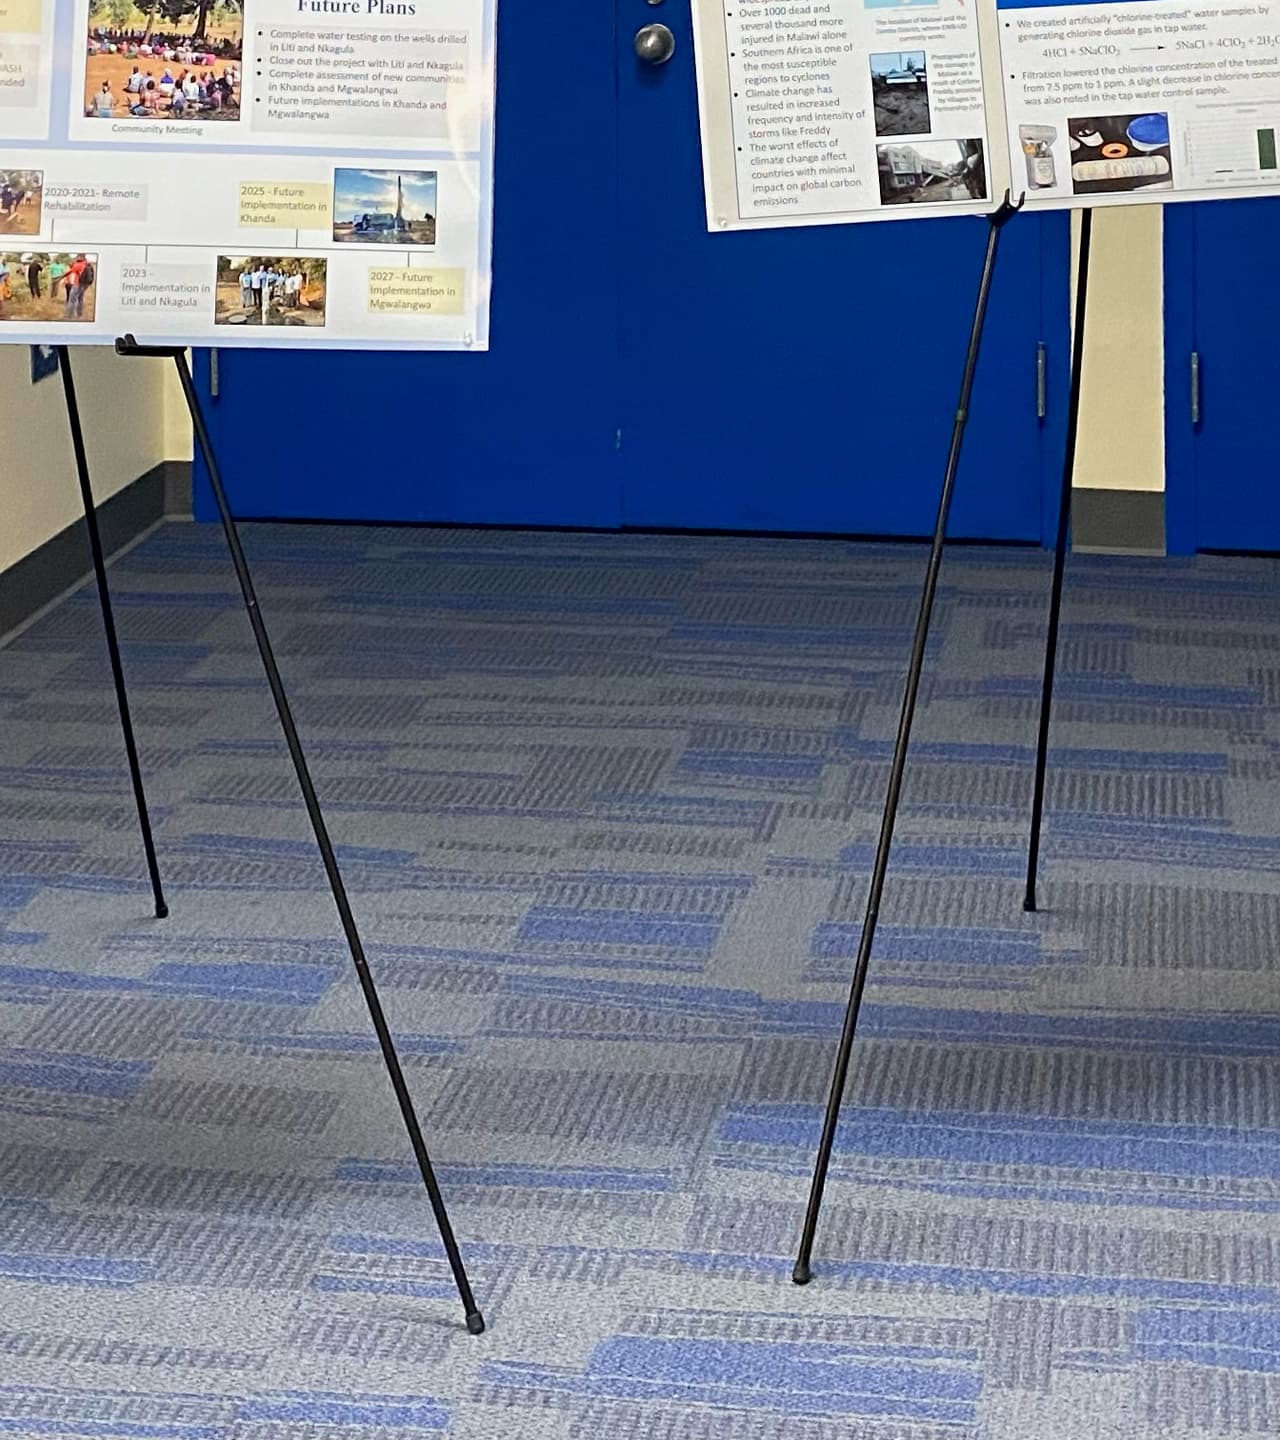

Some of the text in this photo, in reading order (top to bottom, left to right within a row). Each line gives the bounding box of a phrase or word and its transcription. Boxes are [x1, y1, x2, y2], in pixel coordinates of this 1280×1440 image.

[367, 0, 415, 15] Plans
[739, 4, 830, 17] Over 1000 dead and
[269, 30, 316, 41] Complete
[317, 31, 345, 40] water
[346, 32, 378, 43] testing
[394, 32, 409, 42] the
[411, 32, 435, 43] wells
[437, 32, 468, 44] drilled
[269, 42, 354, 55] in Liti and Nkagula
[269, 55, 463, 72] Close out the project with Liti and Nkagula
